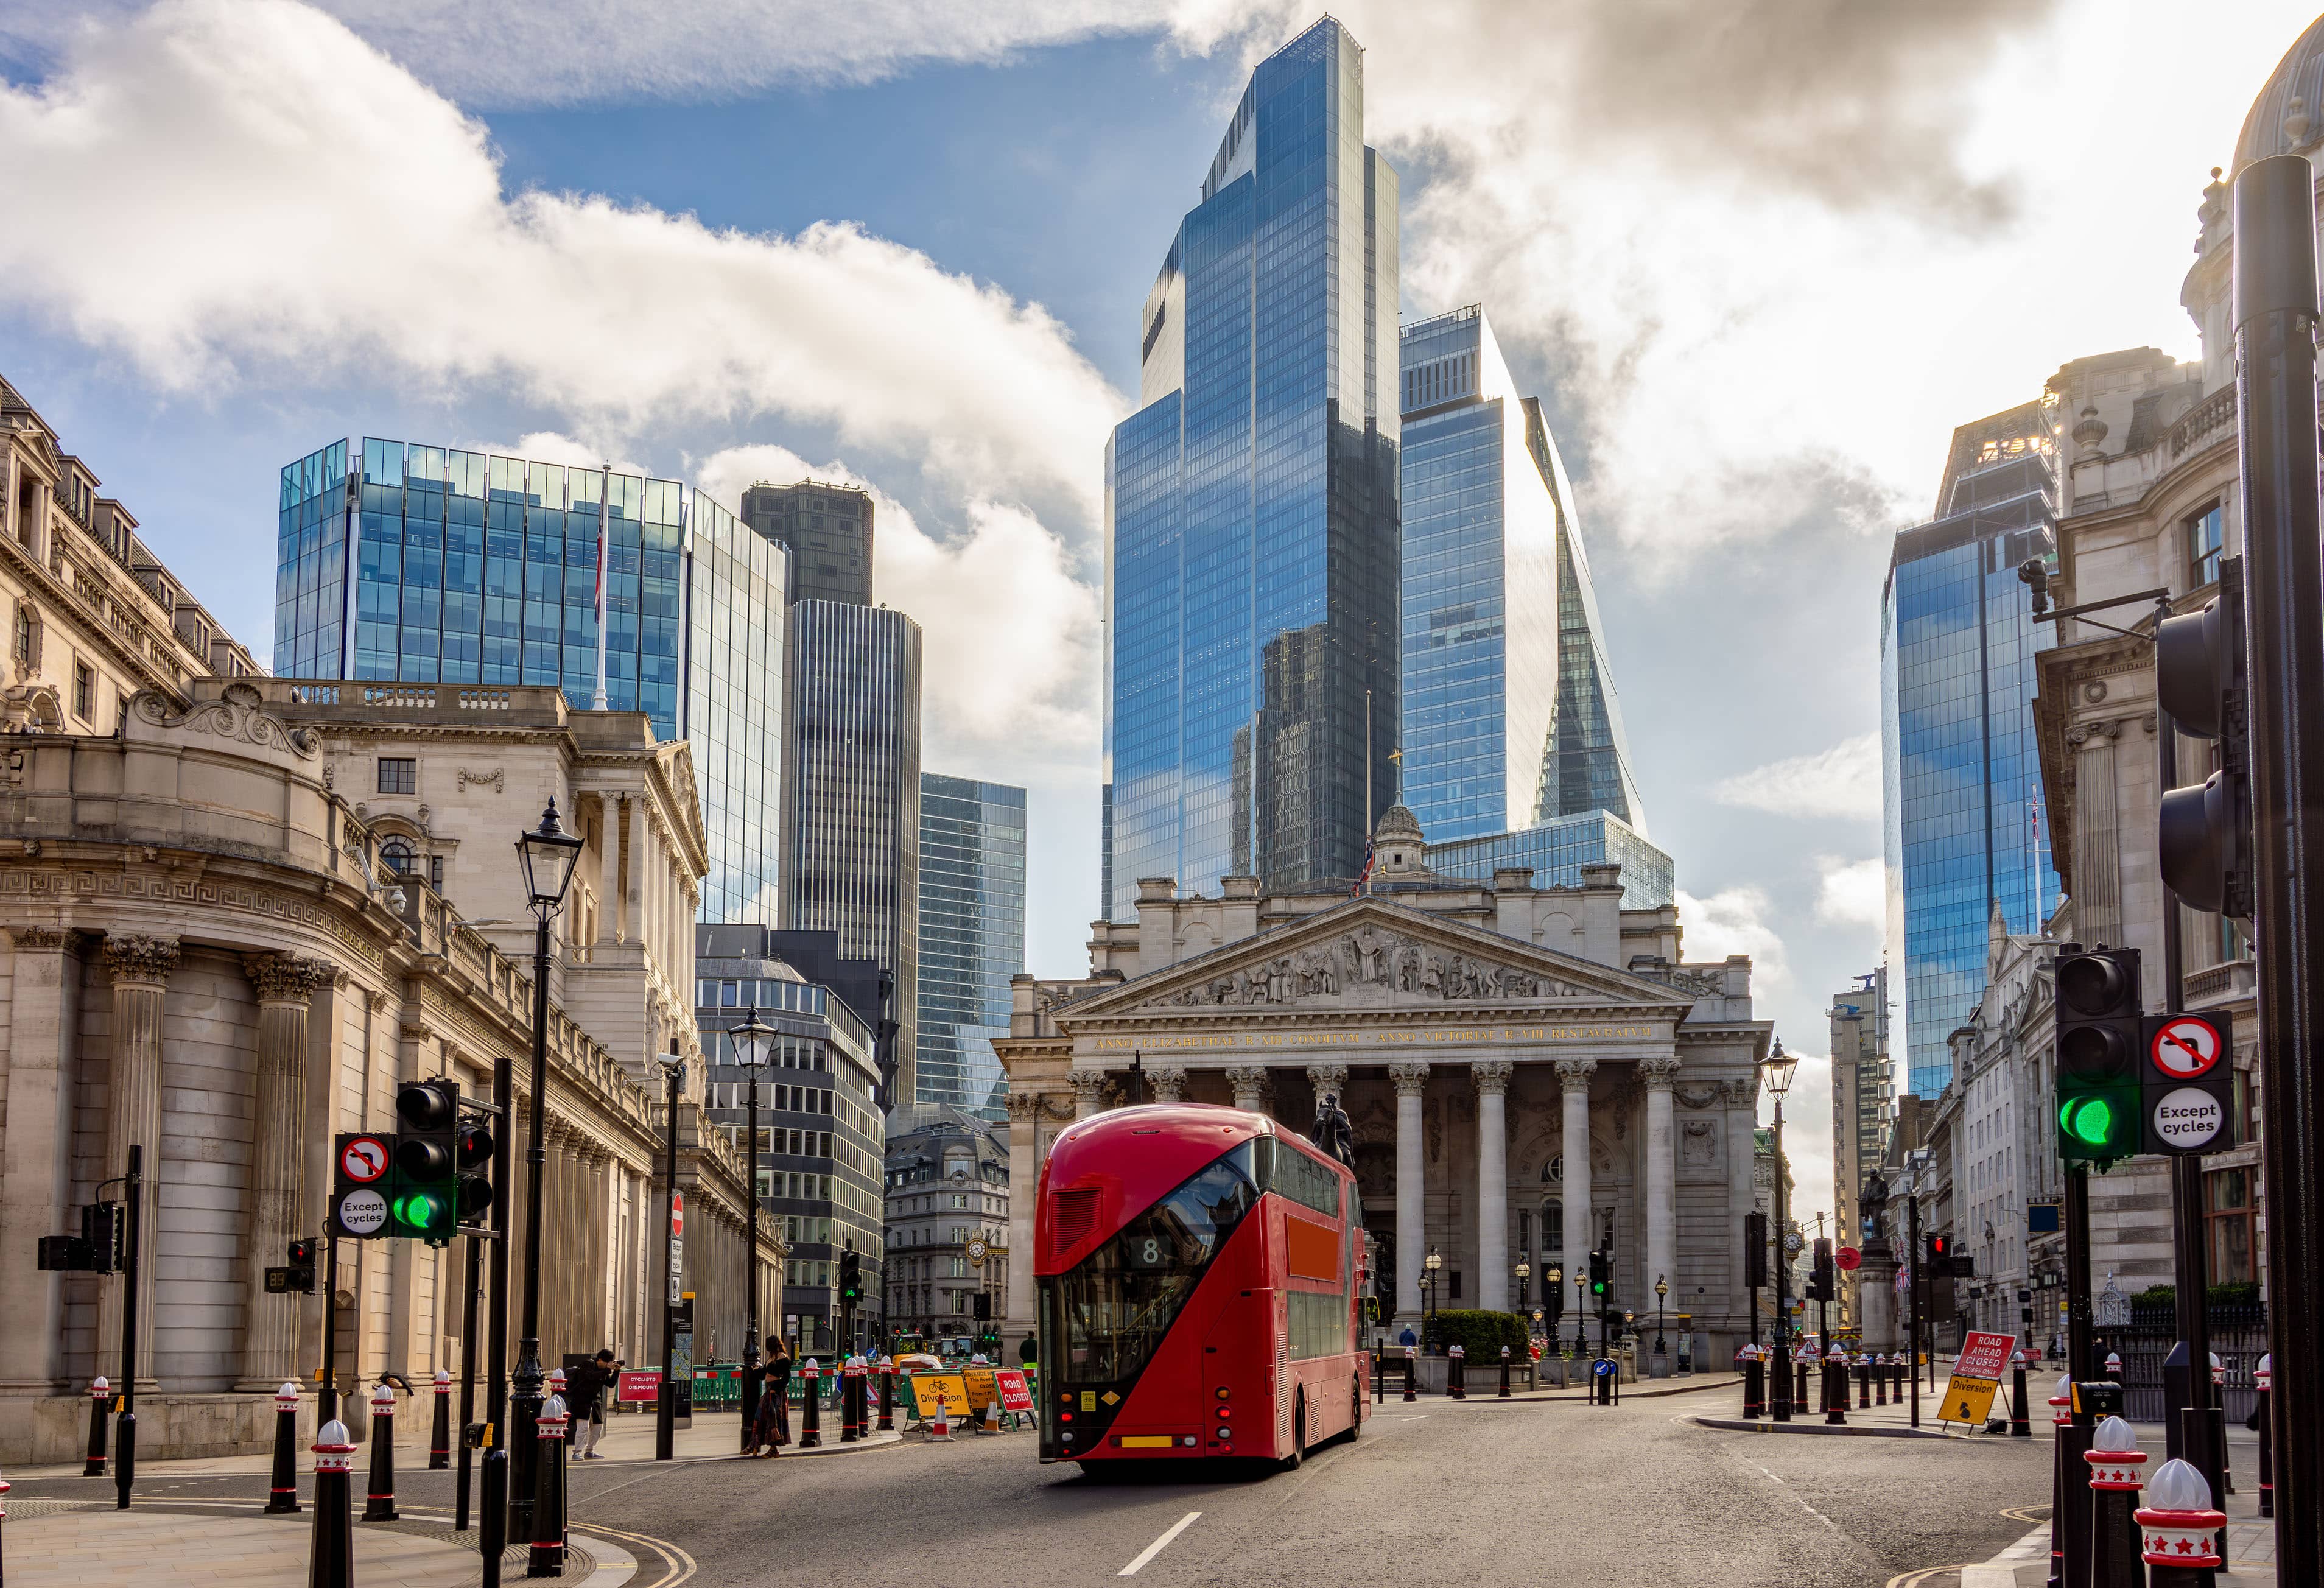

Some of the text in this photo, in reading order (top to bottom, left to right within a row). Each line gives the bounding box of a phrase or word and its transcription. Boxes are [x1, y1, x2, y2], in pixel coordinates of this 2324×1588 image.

[1095, 1038, 1133, 1049] ANNO
[1142, 1036, 1237, 1048] ELIZABETHAE
[1246, 1036, 1254, 1045] R
[1290, 1033, 1359, 1044] CONDITVM
[1376, 1032, 1416, 1043] ANNO
[1424, 1030, 1496, 1042] VICTORIAE
[1505, 1029, 1514, 1040] R
[1522, 1029, 1543, 1039] VIII
[1551, 1027, 1651, 1039] RESTAVRATVM
[2160, 1105, 2216, 1118] Except
[2163, 1120, 2214, 1135] cycles
[345, 1202, 383, 1212] Except
[346, 1214, 382, 1224] cycles
[1143, 1238, 1158, 1263] 8
[1978, 1336, 2002, 1346] ROAD
[1971, 1347, 2002, 1357] AHEAD
[1965, 1357, 2000, 1367] CLOSED
[1953, 1380, 1992, 1393] Diversion
[921, 1393, 962, 1402] Divesion
[1005, 1393, 1029, 1402] CLOSED
